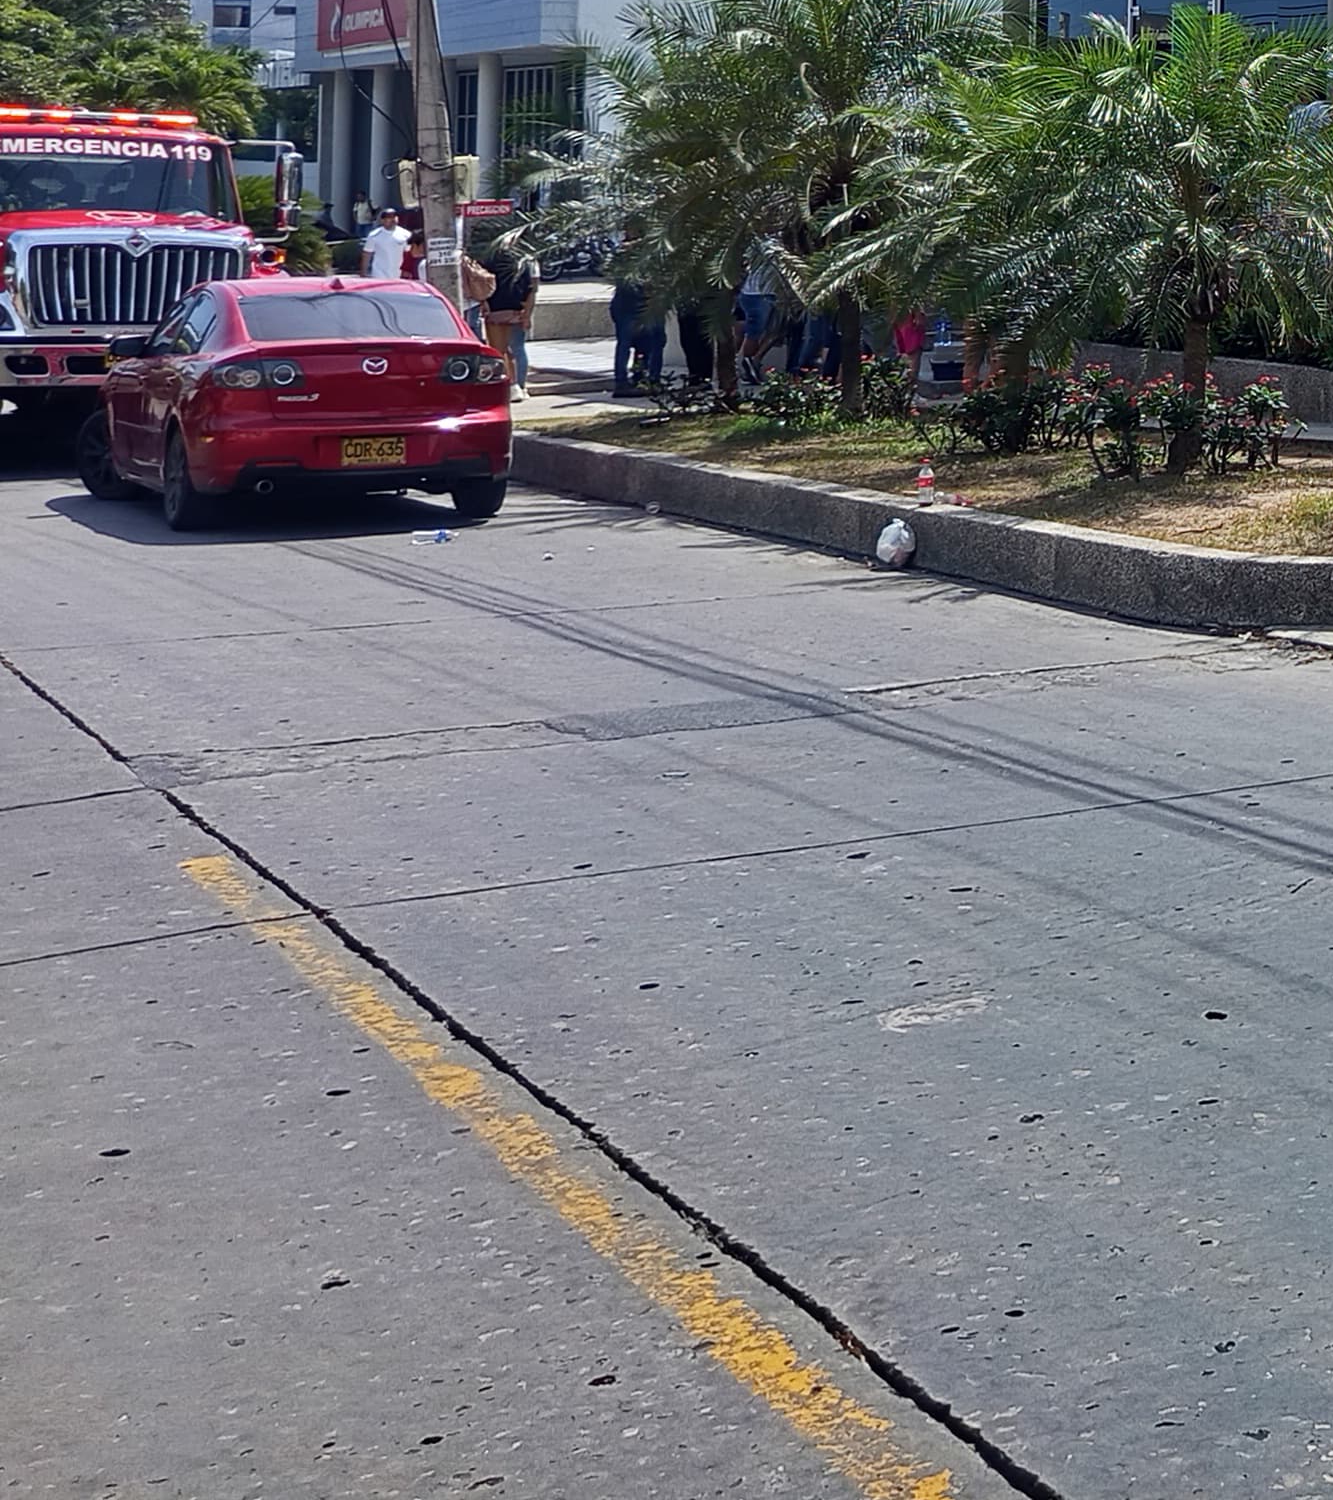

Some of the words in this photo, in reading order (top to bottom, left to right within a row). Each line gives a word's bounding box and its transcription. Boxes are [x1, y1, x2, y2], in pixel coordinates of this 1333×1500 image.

[0, 137, 169, 159] MERGENCIA
[170, 144, 213, 162] 119
[344, 441, 404, 458] CDR-635
